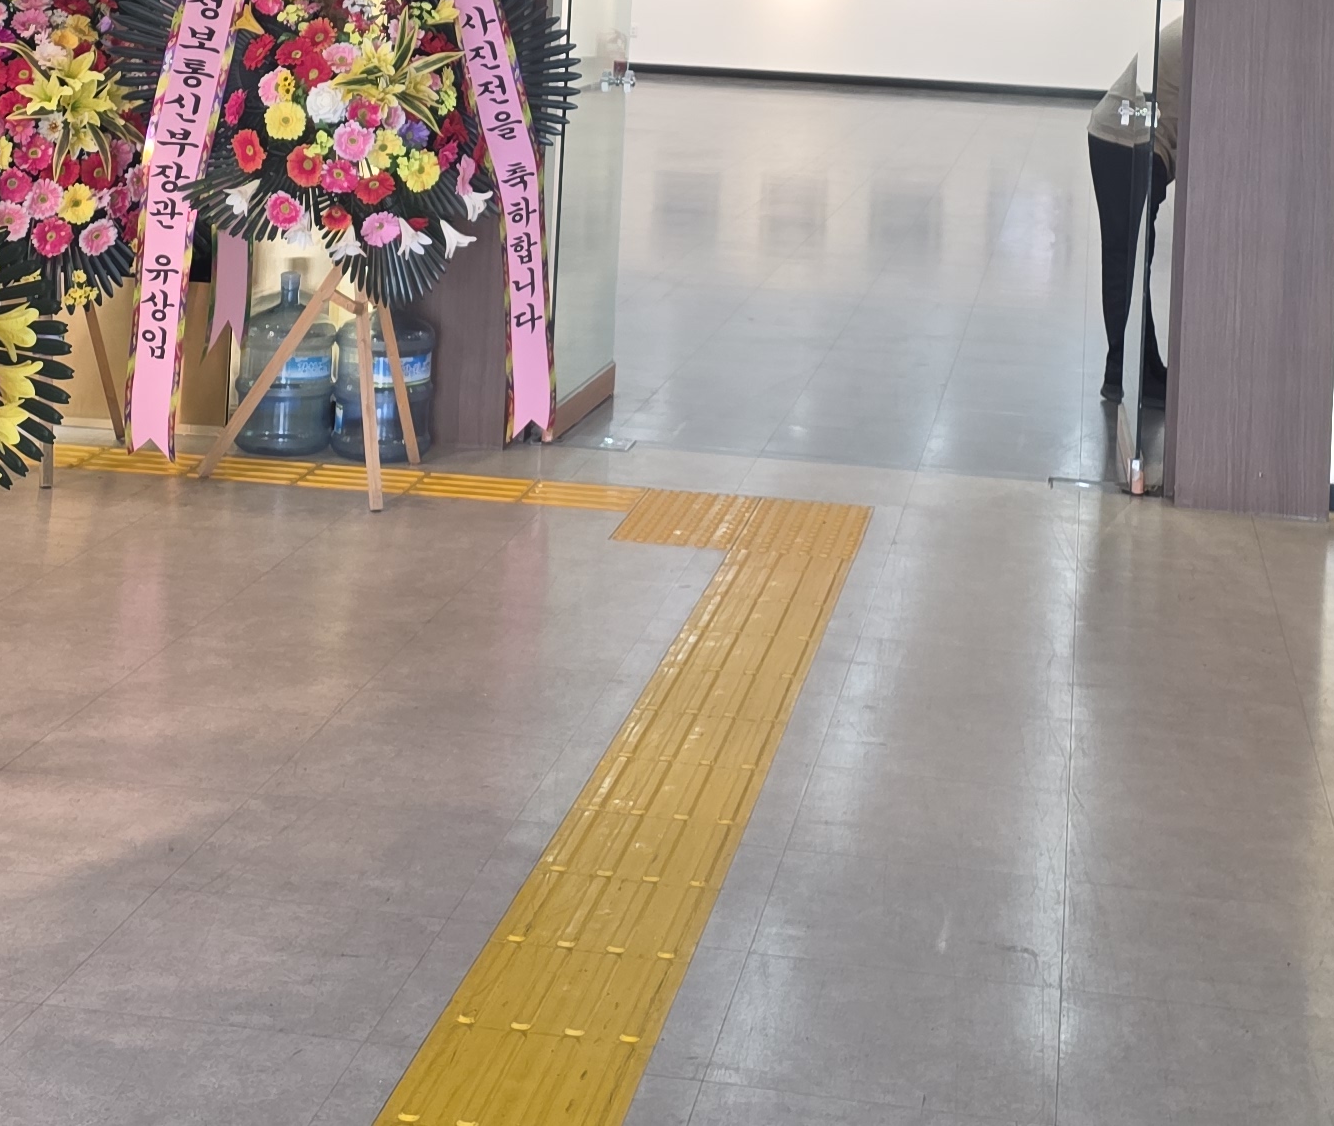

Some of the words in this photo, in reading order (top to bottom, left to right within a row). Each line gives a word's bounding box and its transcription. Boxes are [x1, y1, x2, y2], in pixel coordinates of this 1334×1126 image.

[461, 5, 523, 141] 사진전을
[501, 162, 543, 335] 축하합니다
[141, 254, 180, 360] 유상임
